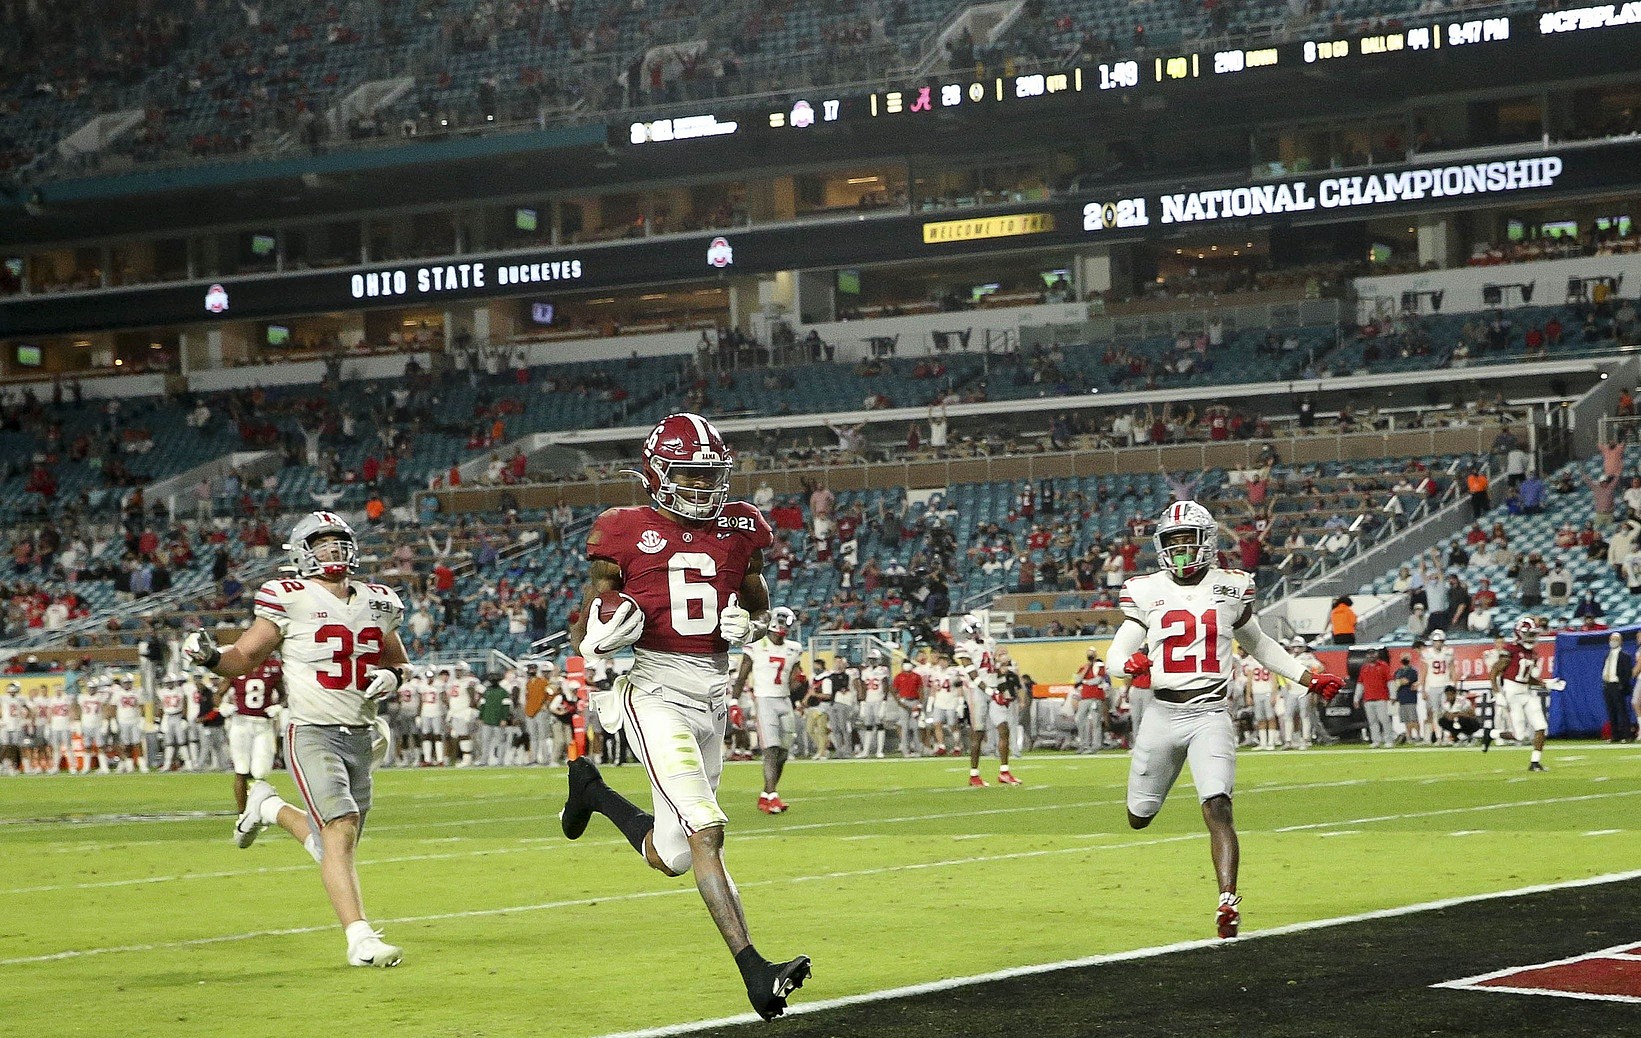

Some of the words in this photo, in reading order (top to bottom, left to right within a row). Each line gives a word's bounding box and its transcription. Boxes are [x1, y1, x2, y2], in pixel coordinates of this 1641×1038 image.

[1098, 60, 1138, 90] 1:49
[1083, 197, 1149, 231] 2021
[1160, 181, 1316, 224] NATIONAL
[1319, 156, 1562, 208] CHAMPIONSHIP
[929, 220, 991, 240] WELCOME
[1000, 219, 1015, 233] TO
[351, 270, 407, 298] OHIO
[417, 263, 485, 292] STATE
[498, 259, 582, 285] BUCKEYES
[717, 516, 757, 532] 2021
[668, 552, 720, 636] 6
[314, 624, 384, 690] 32
[1161, 609, 1220, 673] 21
[769, 656, 786, 685] 7
[245, 678, 265, 709] 8
